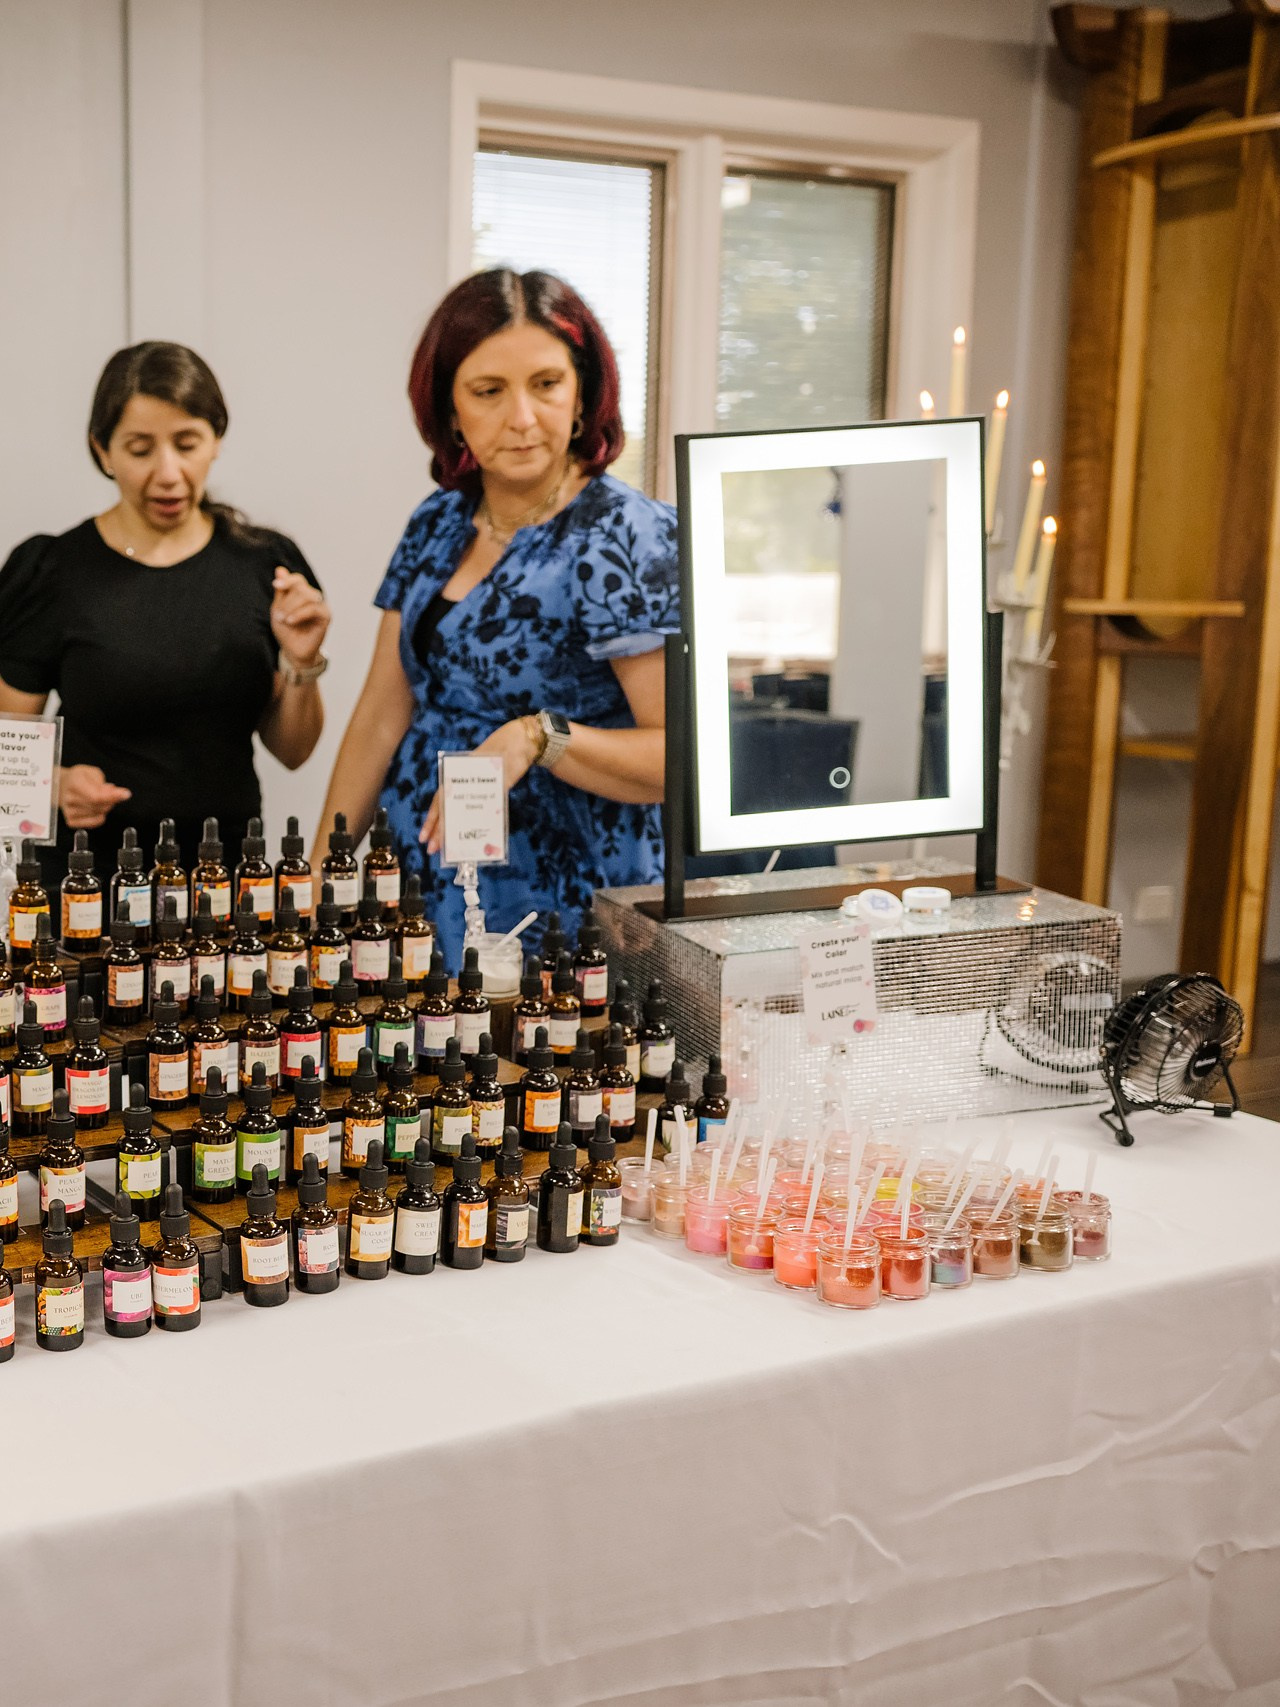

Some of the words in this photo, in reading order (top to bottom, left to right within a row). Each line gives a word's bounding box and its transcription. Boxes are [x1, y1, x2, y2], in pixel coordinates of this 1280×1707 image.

[19, 732, 40, 741] your
[8, 756, 18, 764] up
[21, 779, 37, 788] Oils
[811, 939, 838, 949] Create
[841, 935, 860, 946] your
[825, 949, 848, 959] Color
[825, 968, 839, 976] and
[815, 979, 842, 989] natural
